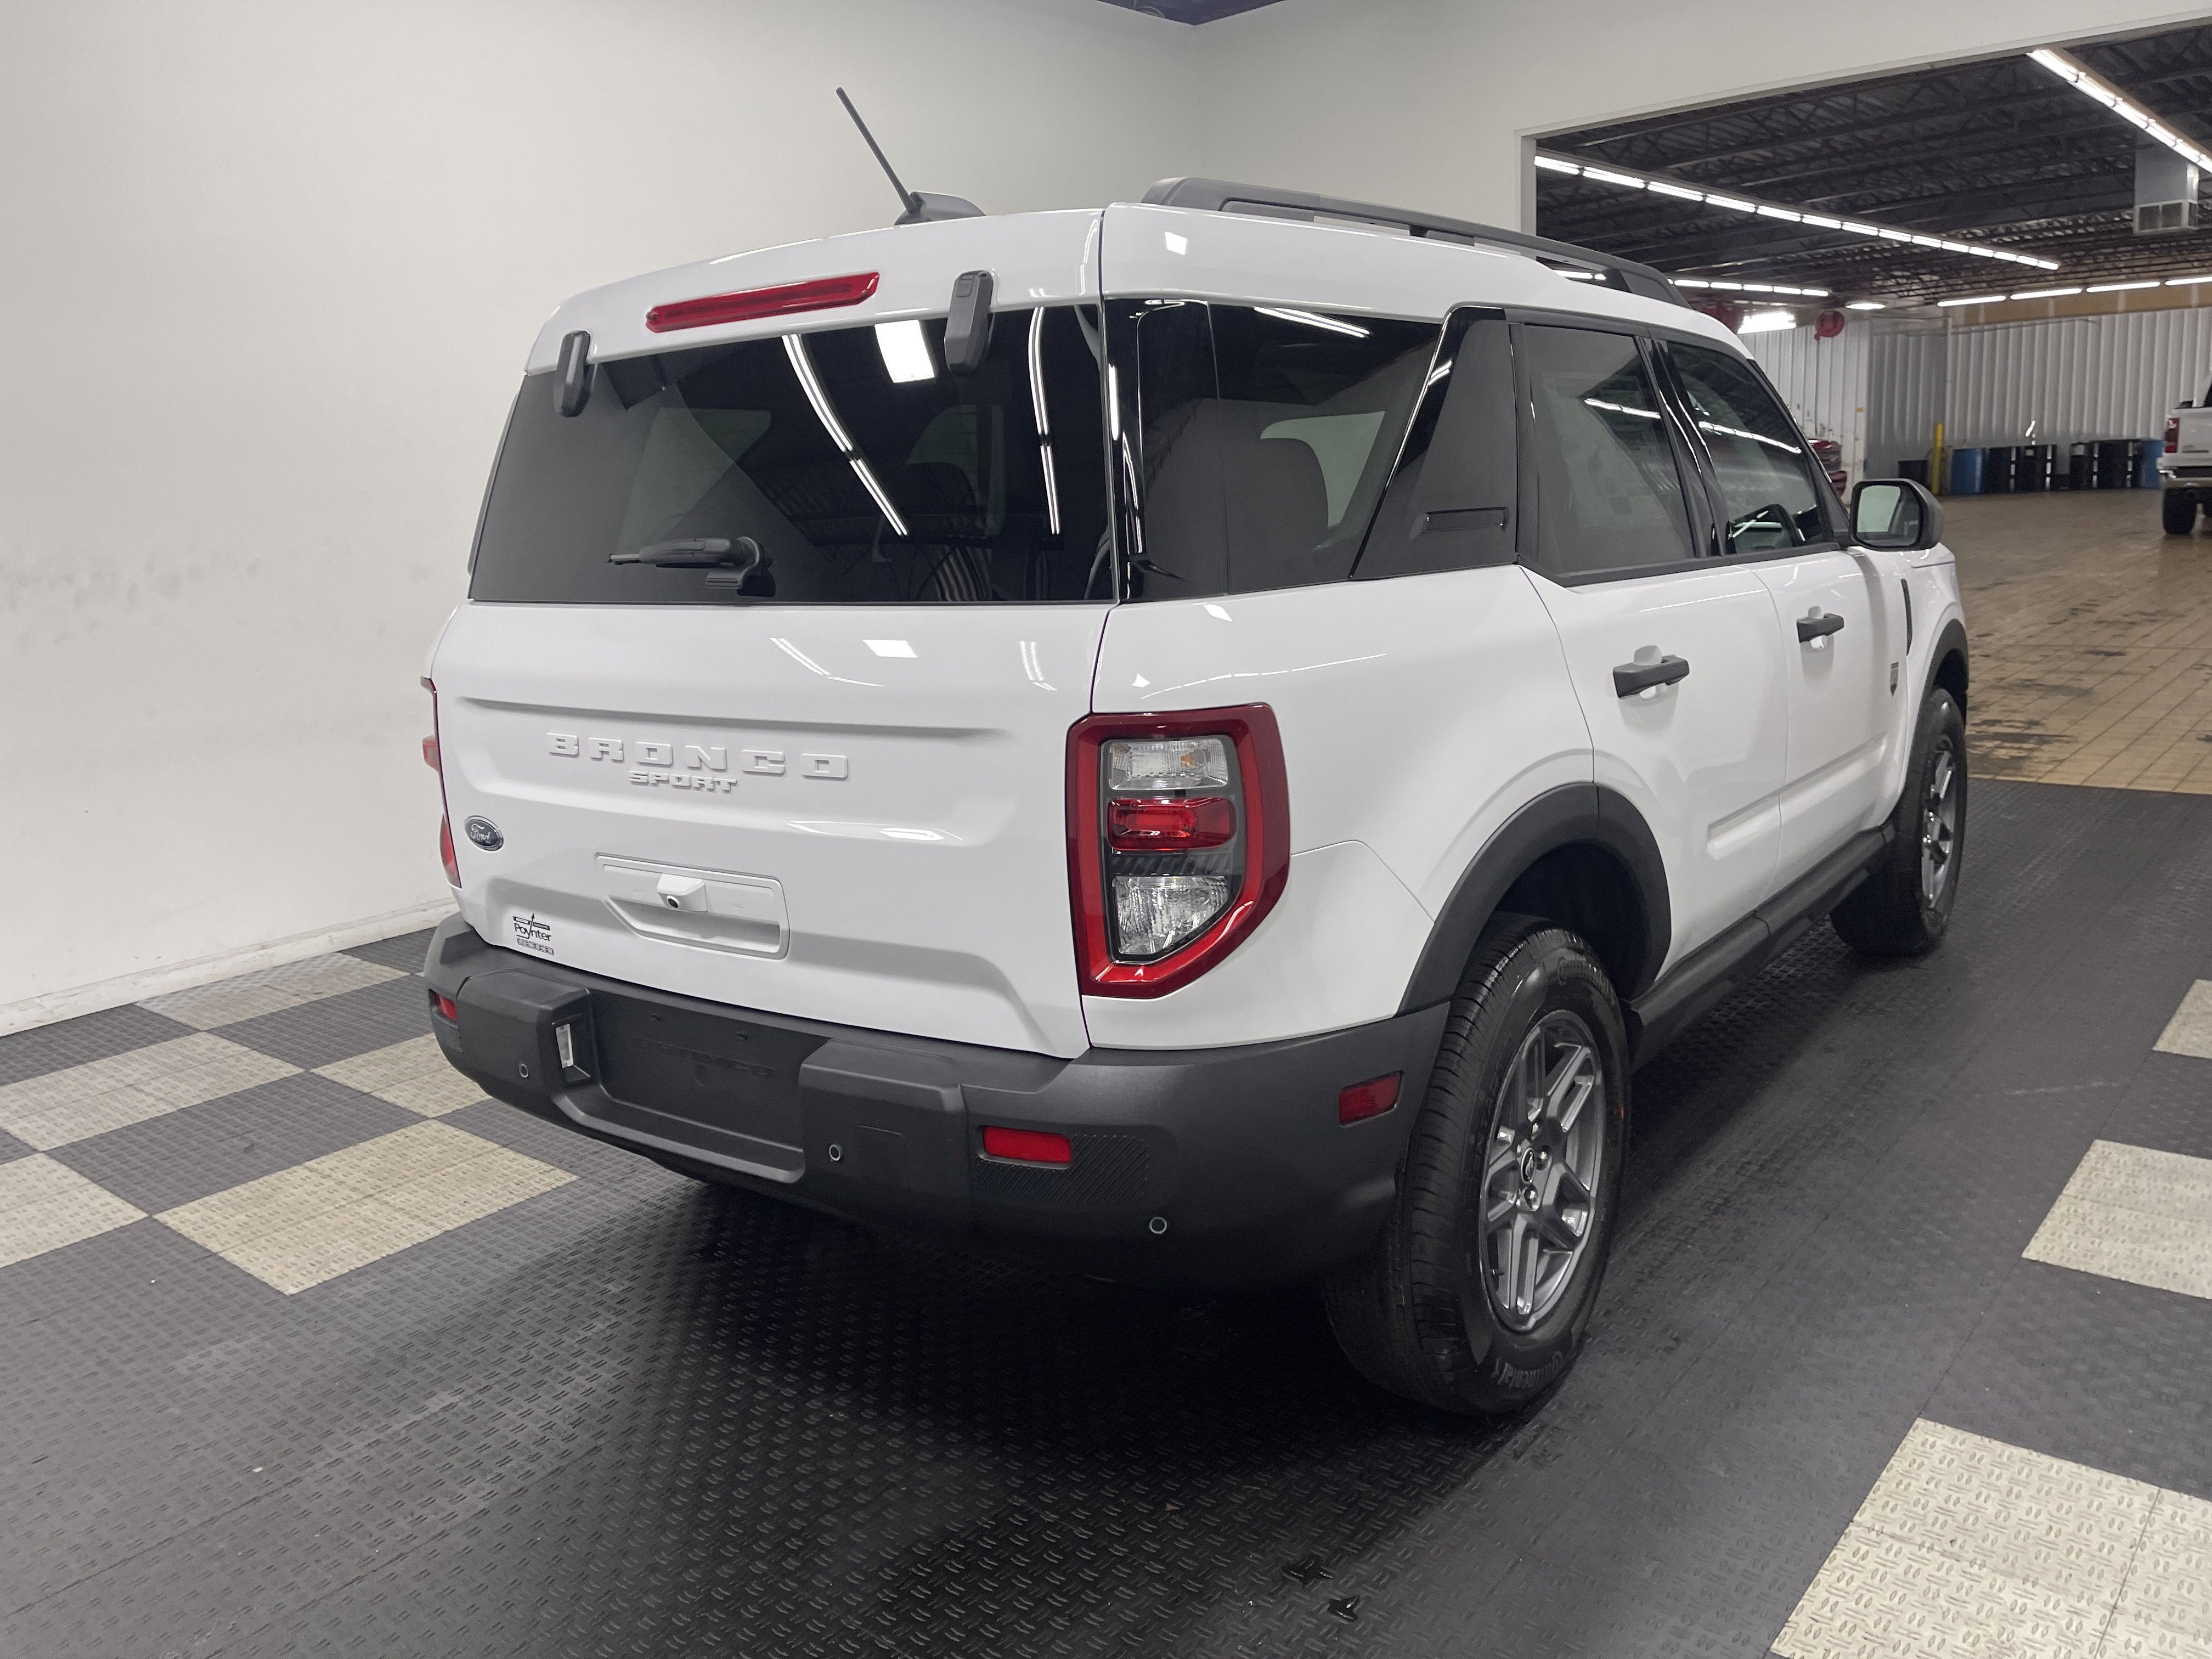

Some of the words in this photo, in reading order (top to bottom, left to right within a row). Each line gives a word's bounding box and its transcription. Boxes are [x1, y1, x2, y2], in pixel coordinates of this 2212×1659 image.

[547, 733, 848, 779] BRONCO
[628, 770, 737, 793] SPORT
[470, 823, 491, 844] Ford
[514, 923, 551, 942] Poynter
